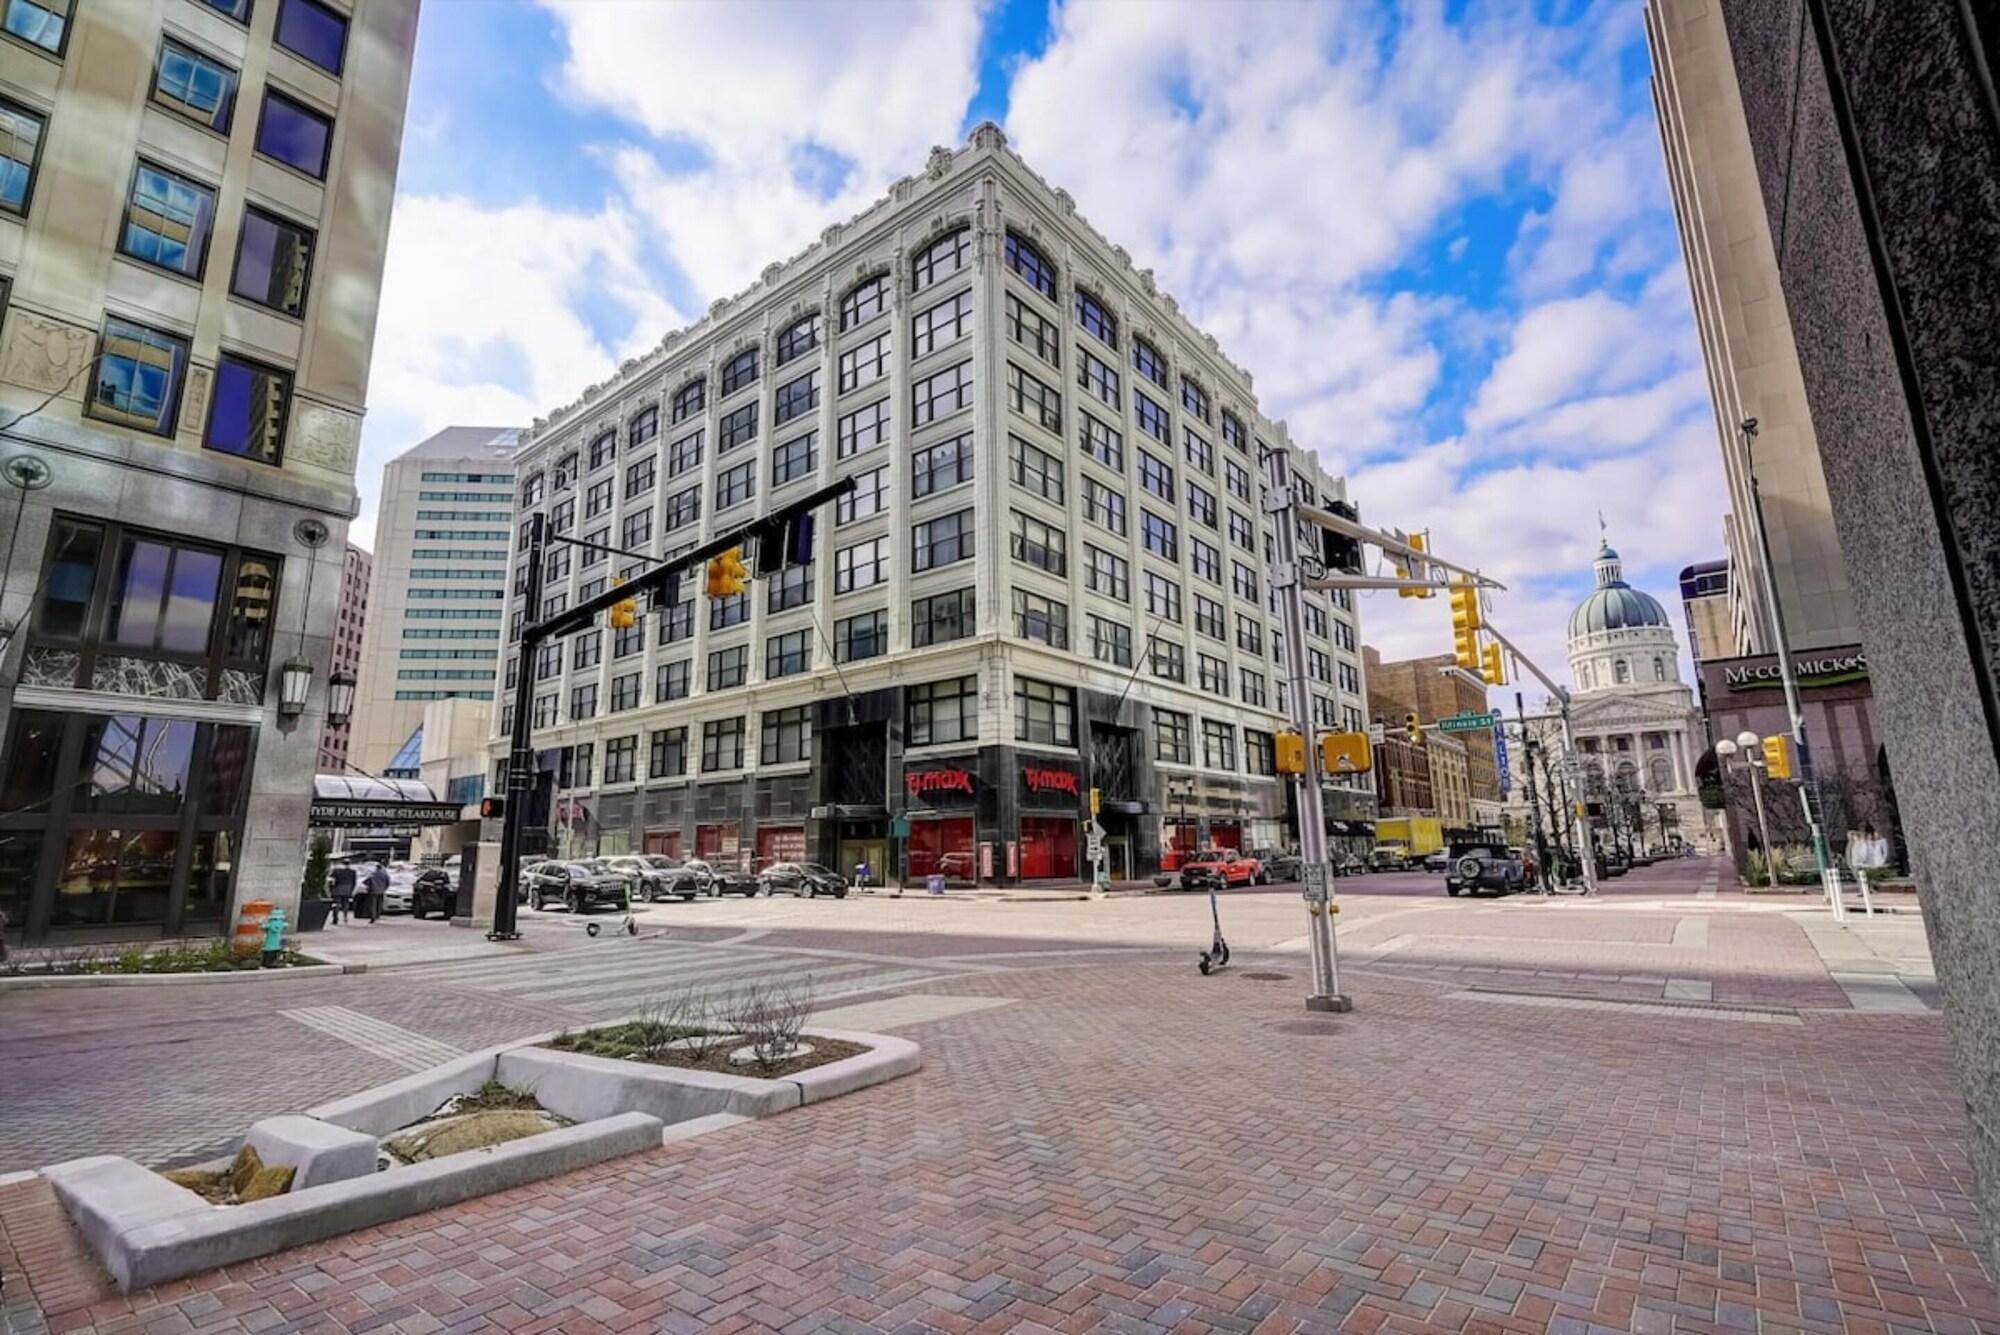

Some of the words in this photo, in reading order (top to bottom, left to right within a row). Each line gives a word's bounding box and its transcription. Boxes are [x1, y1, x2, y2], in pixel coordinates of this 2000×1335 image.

[1480, 717, 1491, 727] St
[337, 807, 365, 818] PARK
[366, 808, 397, 819] PRIME
[398, 808, 457, 819] STEAKHOUSE
